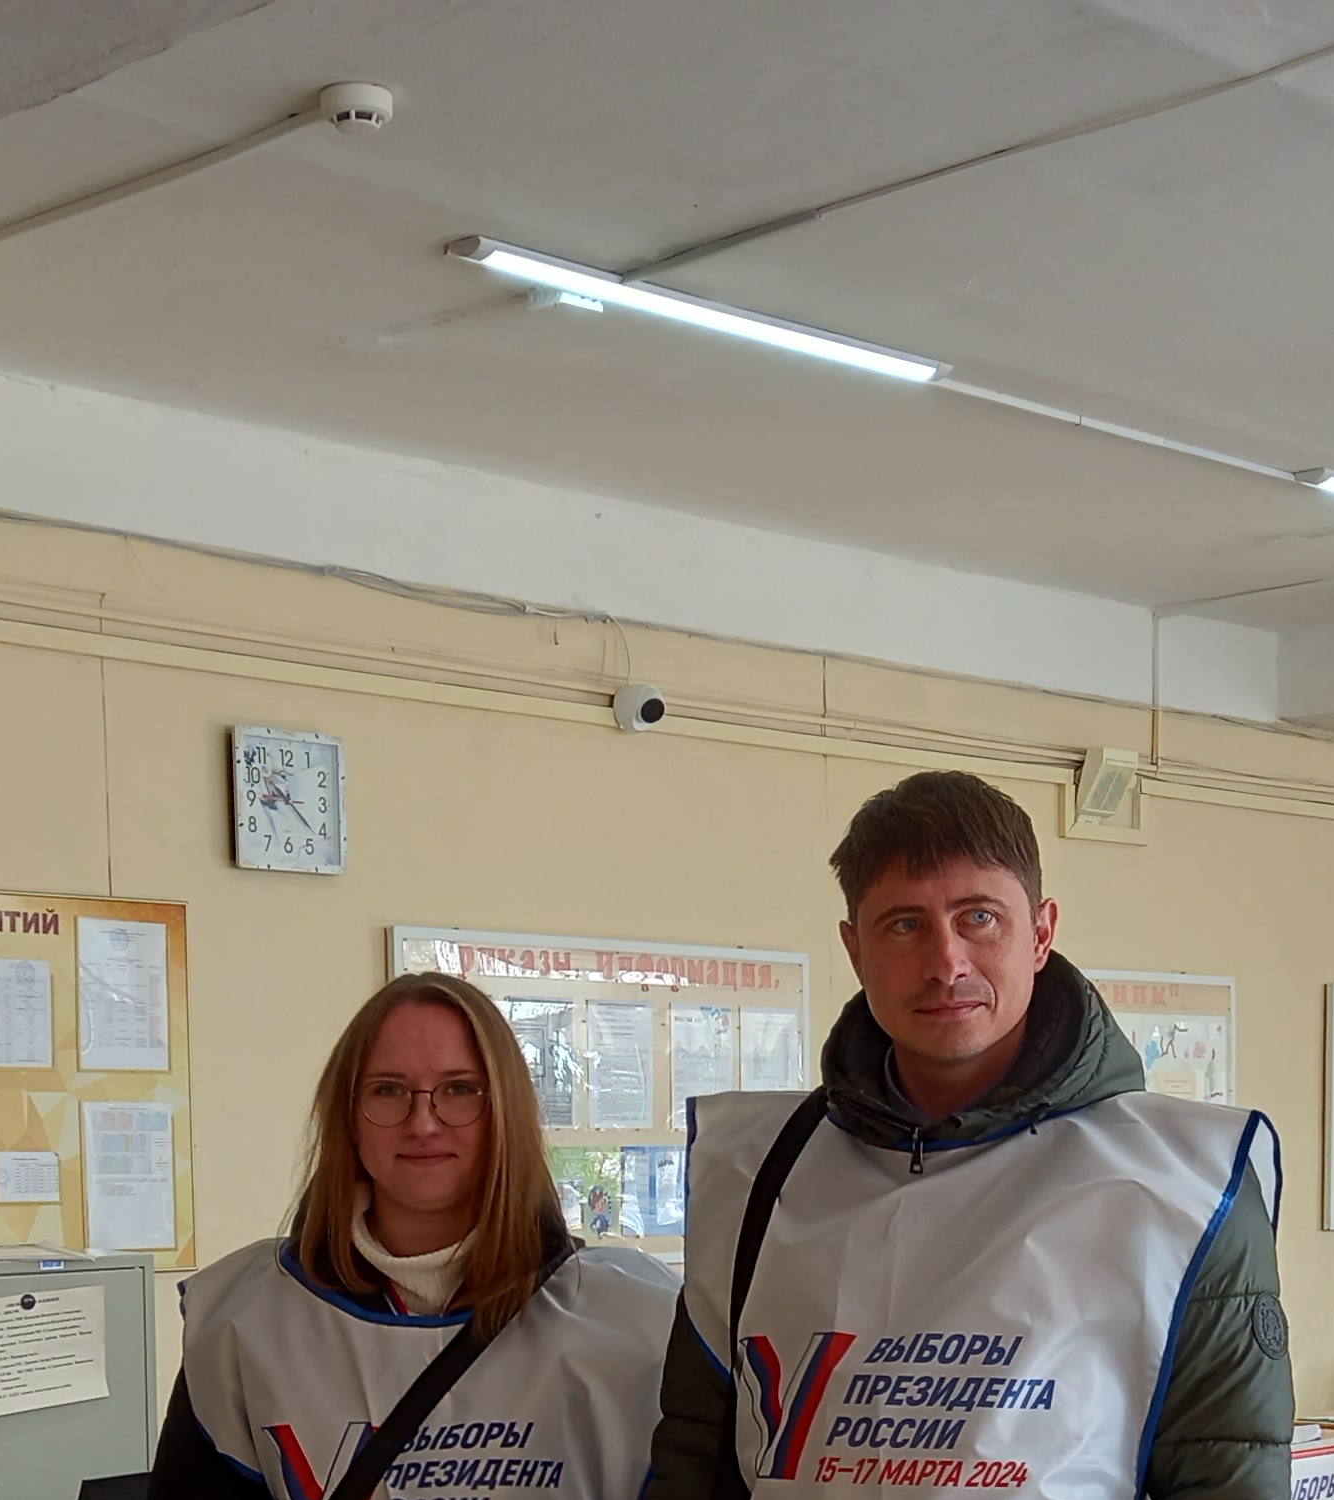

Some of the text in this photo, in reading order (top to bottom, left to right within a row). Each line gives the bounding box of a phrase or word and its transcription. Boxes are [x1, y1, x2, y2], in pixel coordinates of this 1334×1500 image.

[255, 747, 267, 764] 11
[279, 749, 294, 768] 12
[305, 752, 310, 769] 1
[245, 766, 261, 784] 10
[317, 771, 327, 788] 2
[246, 789, 256, 807] 9
[318, 797, 327, 814] 3
[248, 816, 257, 833] 8
[318, 822, 327, 839] 4
[264, 835, 272, 852] 7
[284, 837, 293, 854] 6
[305, 838, 314, 855] 5
[864, 1333, 1023, 1365] ВЫБОРЫ
[843, 1374, 1055, 1412] ПРЕЗИДЕНТА
[825, 1416, 966, 1449] РОССИИ
[878, 1459, 964, 1487] МАРТА
[965, 1461, 1028, 1488] 2024
